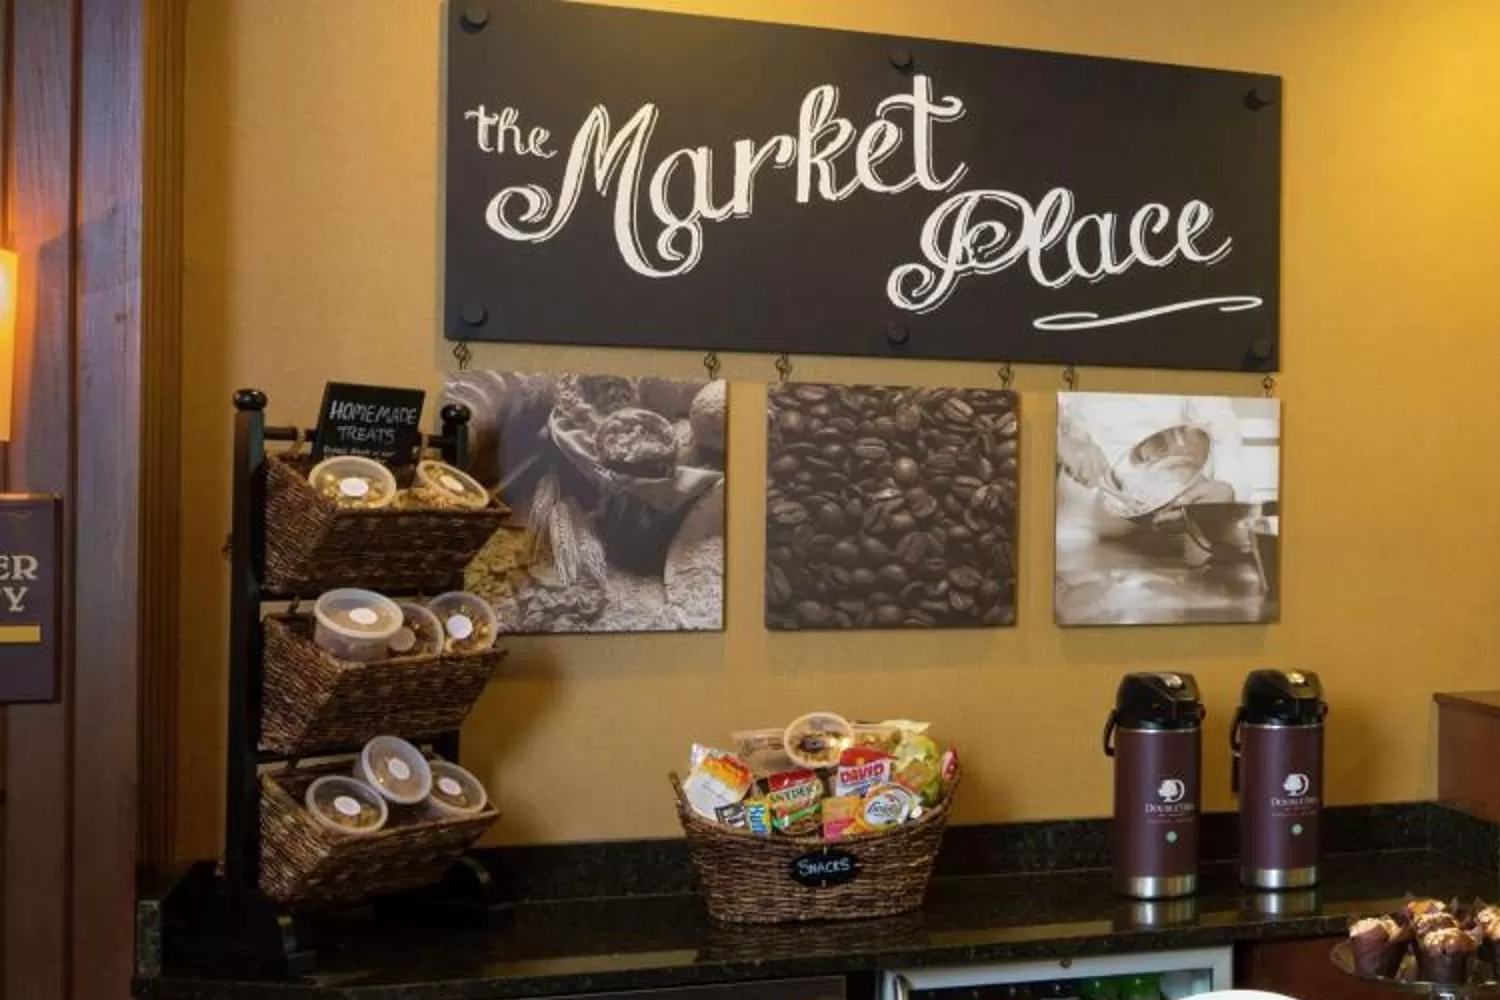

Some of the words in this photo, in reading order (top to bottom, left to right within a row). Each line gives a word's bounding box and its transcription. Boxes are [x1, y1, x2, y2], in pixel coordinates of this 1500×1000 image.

[464, 104, 558, 159] the
[485, 74, 967, 279] Market
[887, 187, 1233, 315] Place
[328, 400, 417, 424] HOMEMADE
[337, 424, 397, 444] TREATS
[797, 858, 850, 876] SNACKS
